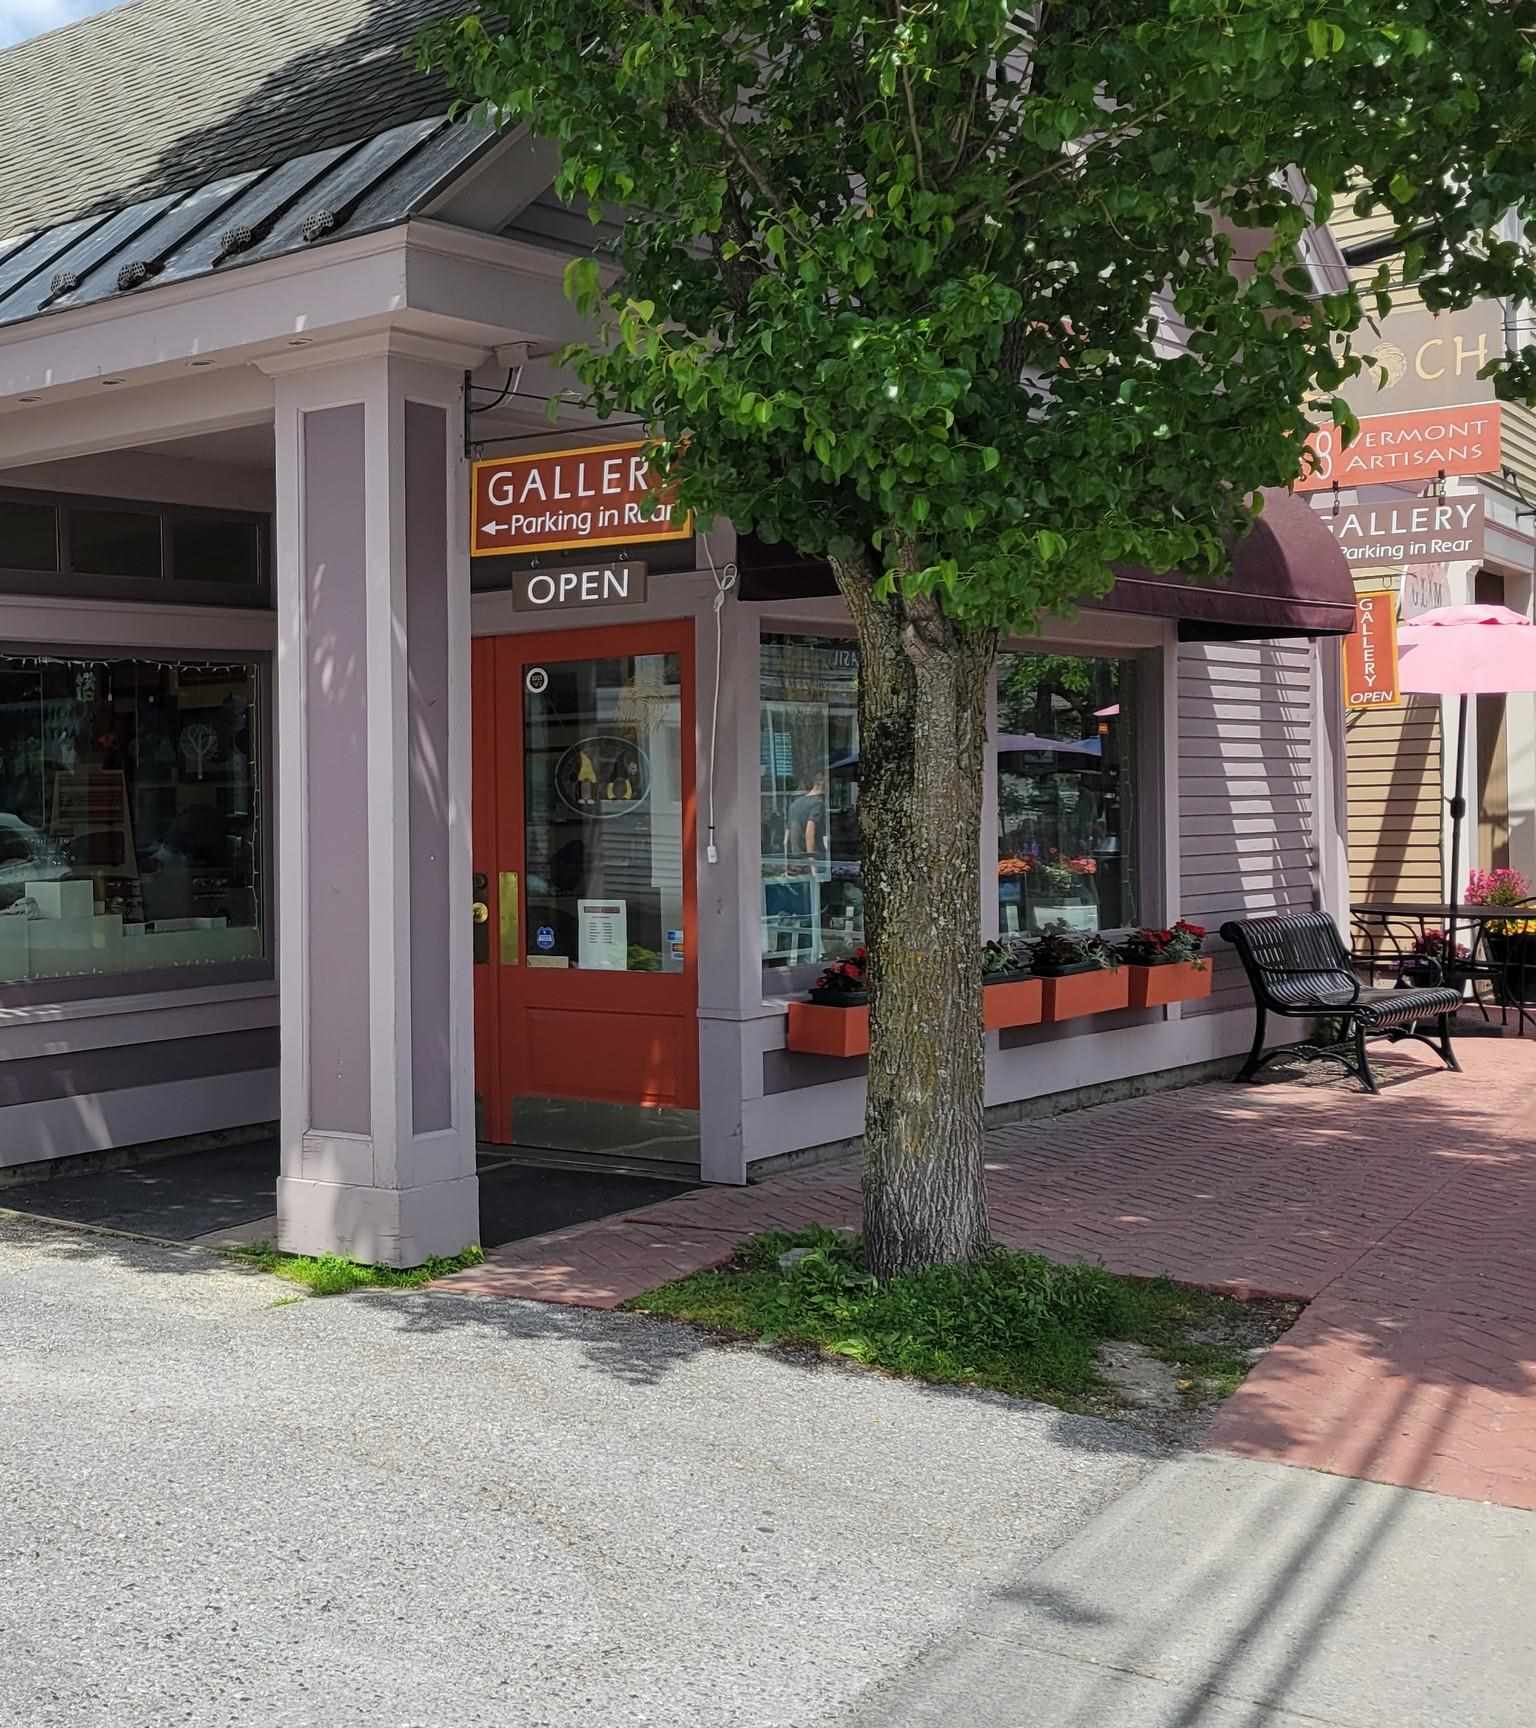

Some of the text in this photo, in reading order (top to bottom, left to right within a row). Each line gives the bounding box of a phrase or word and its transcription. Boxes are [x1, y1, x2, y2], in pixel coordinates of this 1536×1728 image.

[1345, 444, 1483, 473] ARTISANS
[488, 456, 671, 507] GALLER
[511, 509, 592, 536] Parking
[598, 506, 618, 528] in
[1410, 541, 1426, 556] in
[1431, 538, 1473, 554] Rear
[527, 568, 629, 605] OPEN
[1359, 598, 1377, 687] GALLERY
[1351, 691, 1393, 704] OPEN
